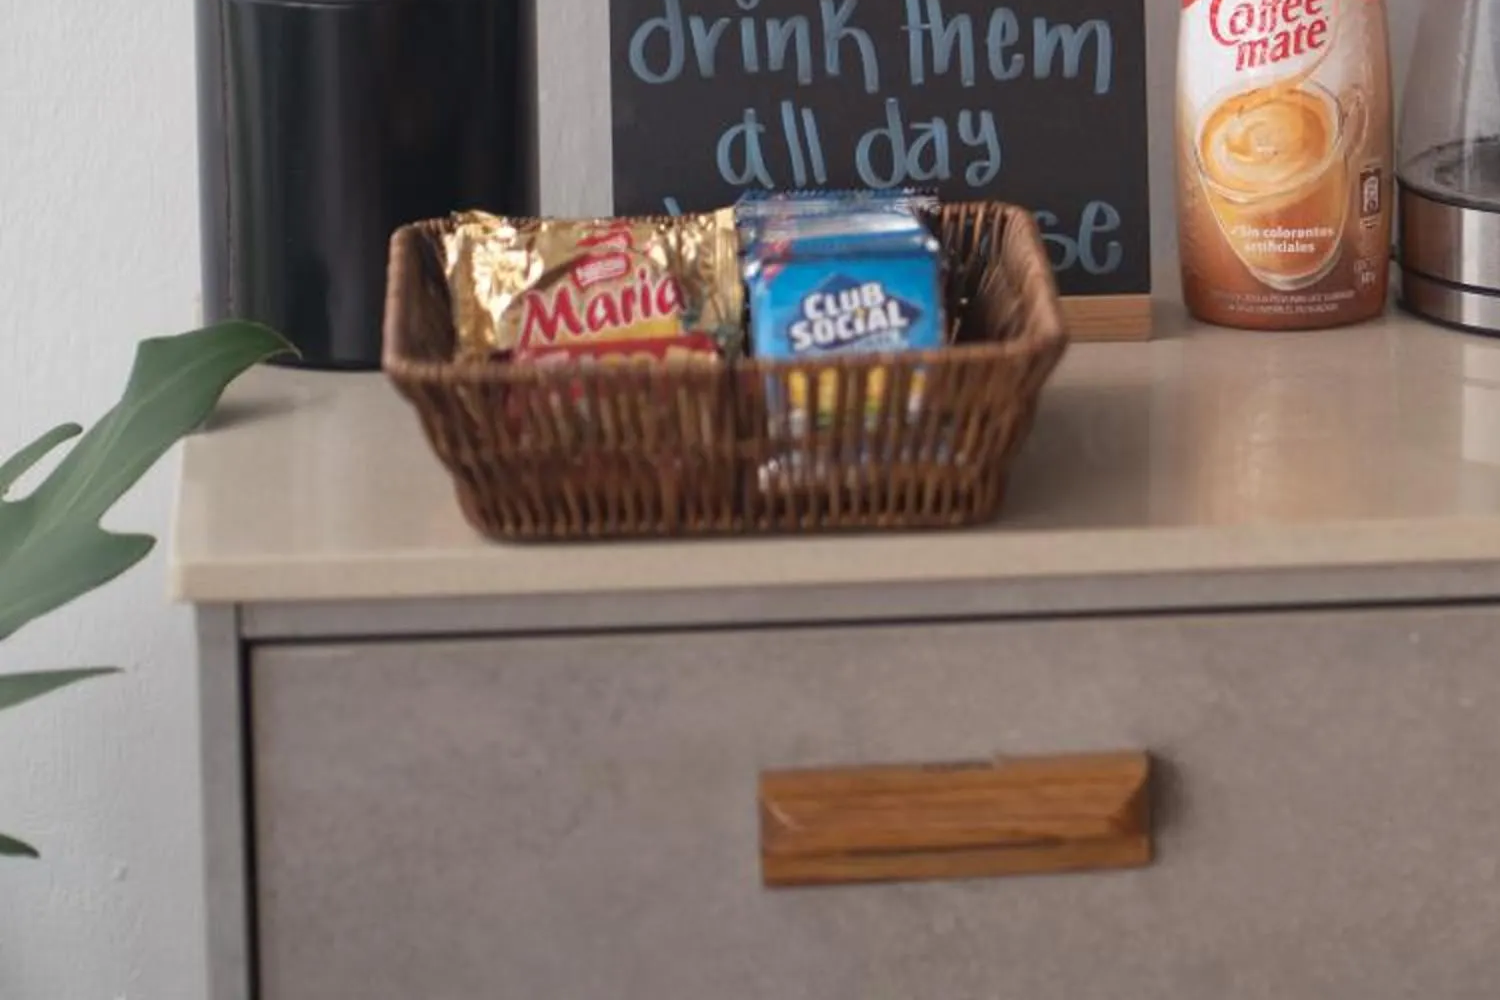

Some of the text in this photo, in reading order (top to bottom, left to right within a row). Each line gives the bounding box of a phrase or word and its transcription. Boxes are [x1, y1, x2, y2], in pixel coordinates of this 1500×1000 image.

[1235, 18, 1327, 72] mate
[716, 97, 1001, 189] all day
[1262, 225, 1334, 239] colorantes
[519, 267, 687, 353] Maria
[803, 281, 886, 322] CLUB
